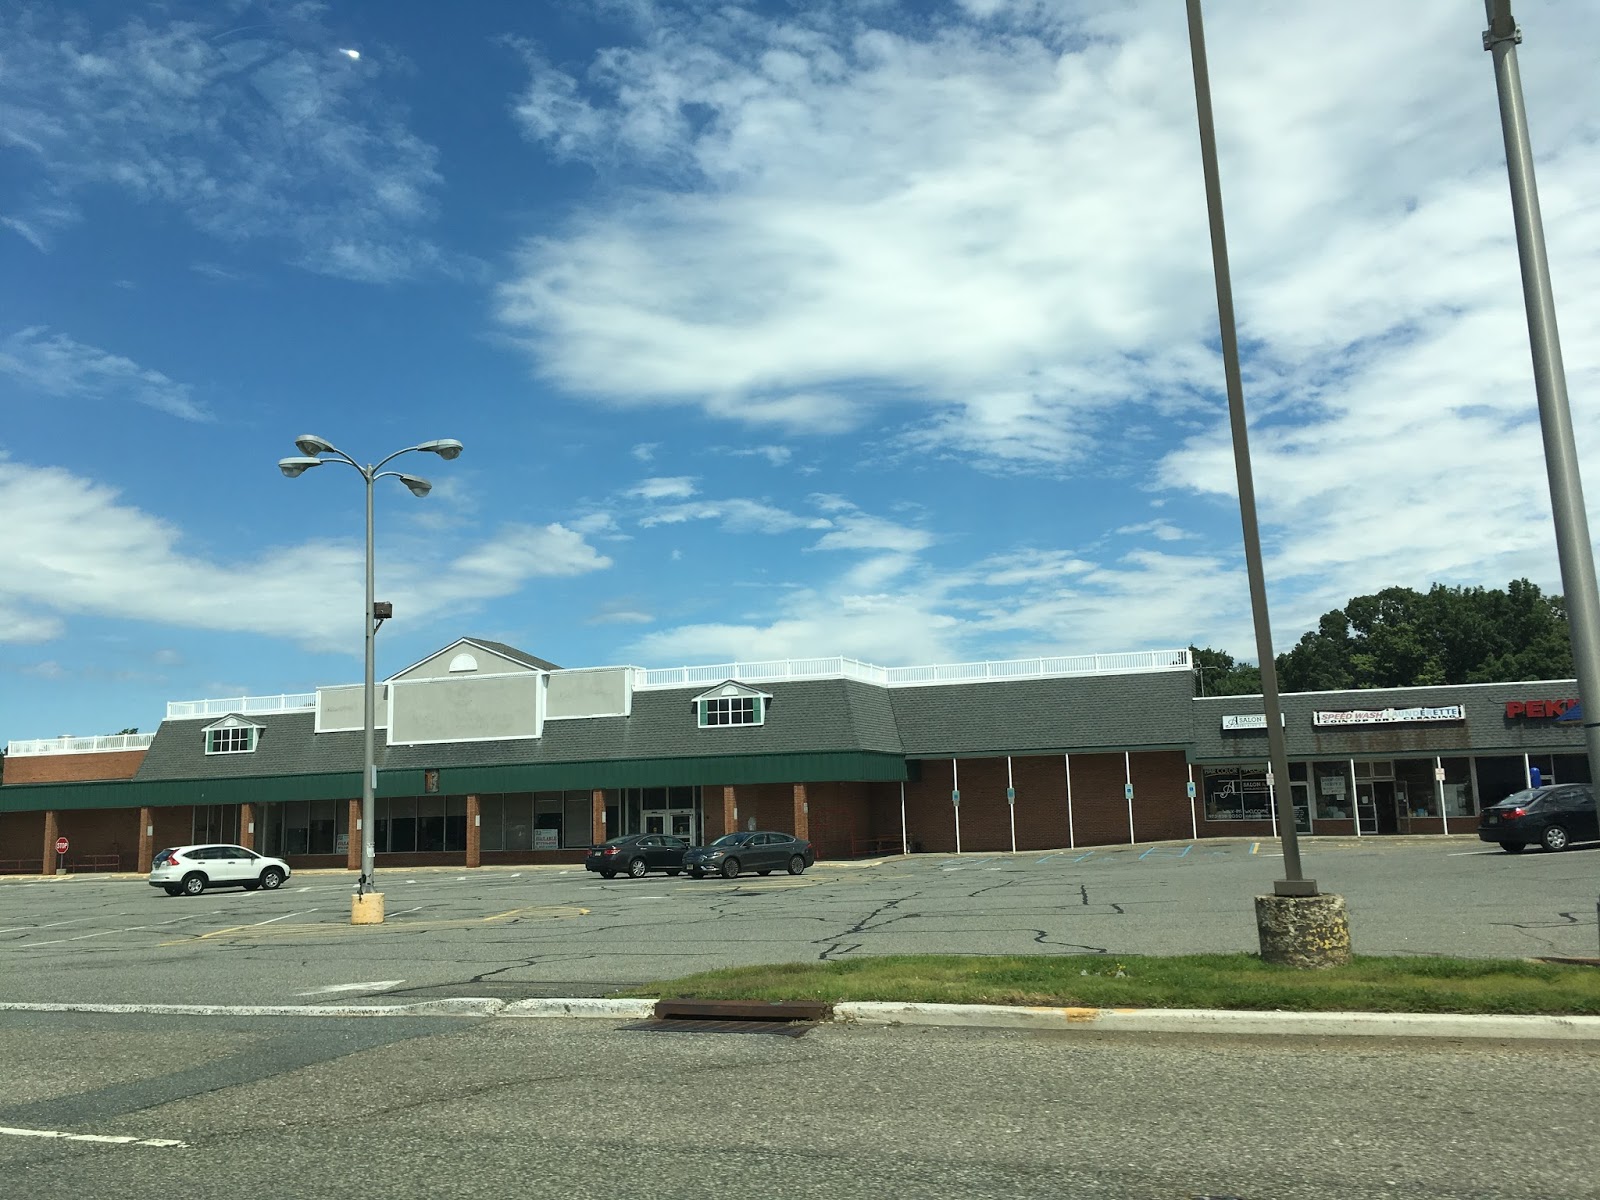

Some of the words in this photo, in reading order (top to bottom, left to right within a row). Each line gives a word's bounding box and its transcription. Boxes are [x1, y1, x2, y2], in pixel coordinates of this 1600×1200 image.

[1321, 712, 1352, 721] SPEED
[1354, 711, 1383, 719] WASH
[1387, 708, 1457, 718] LAUNDERETTE
